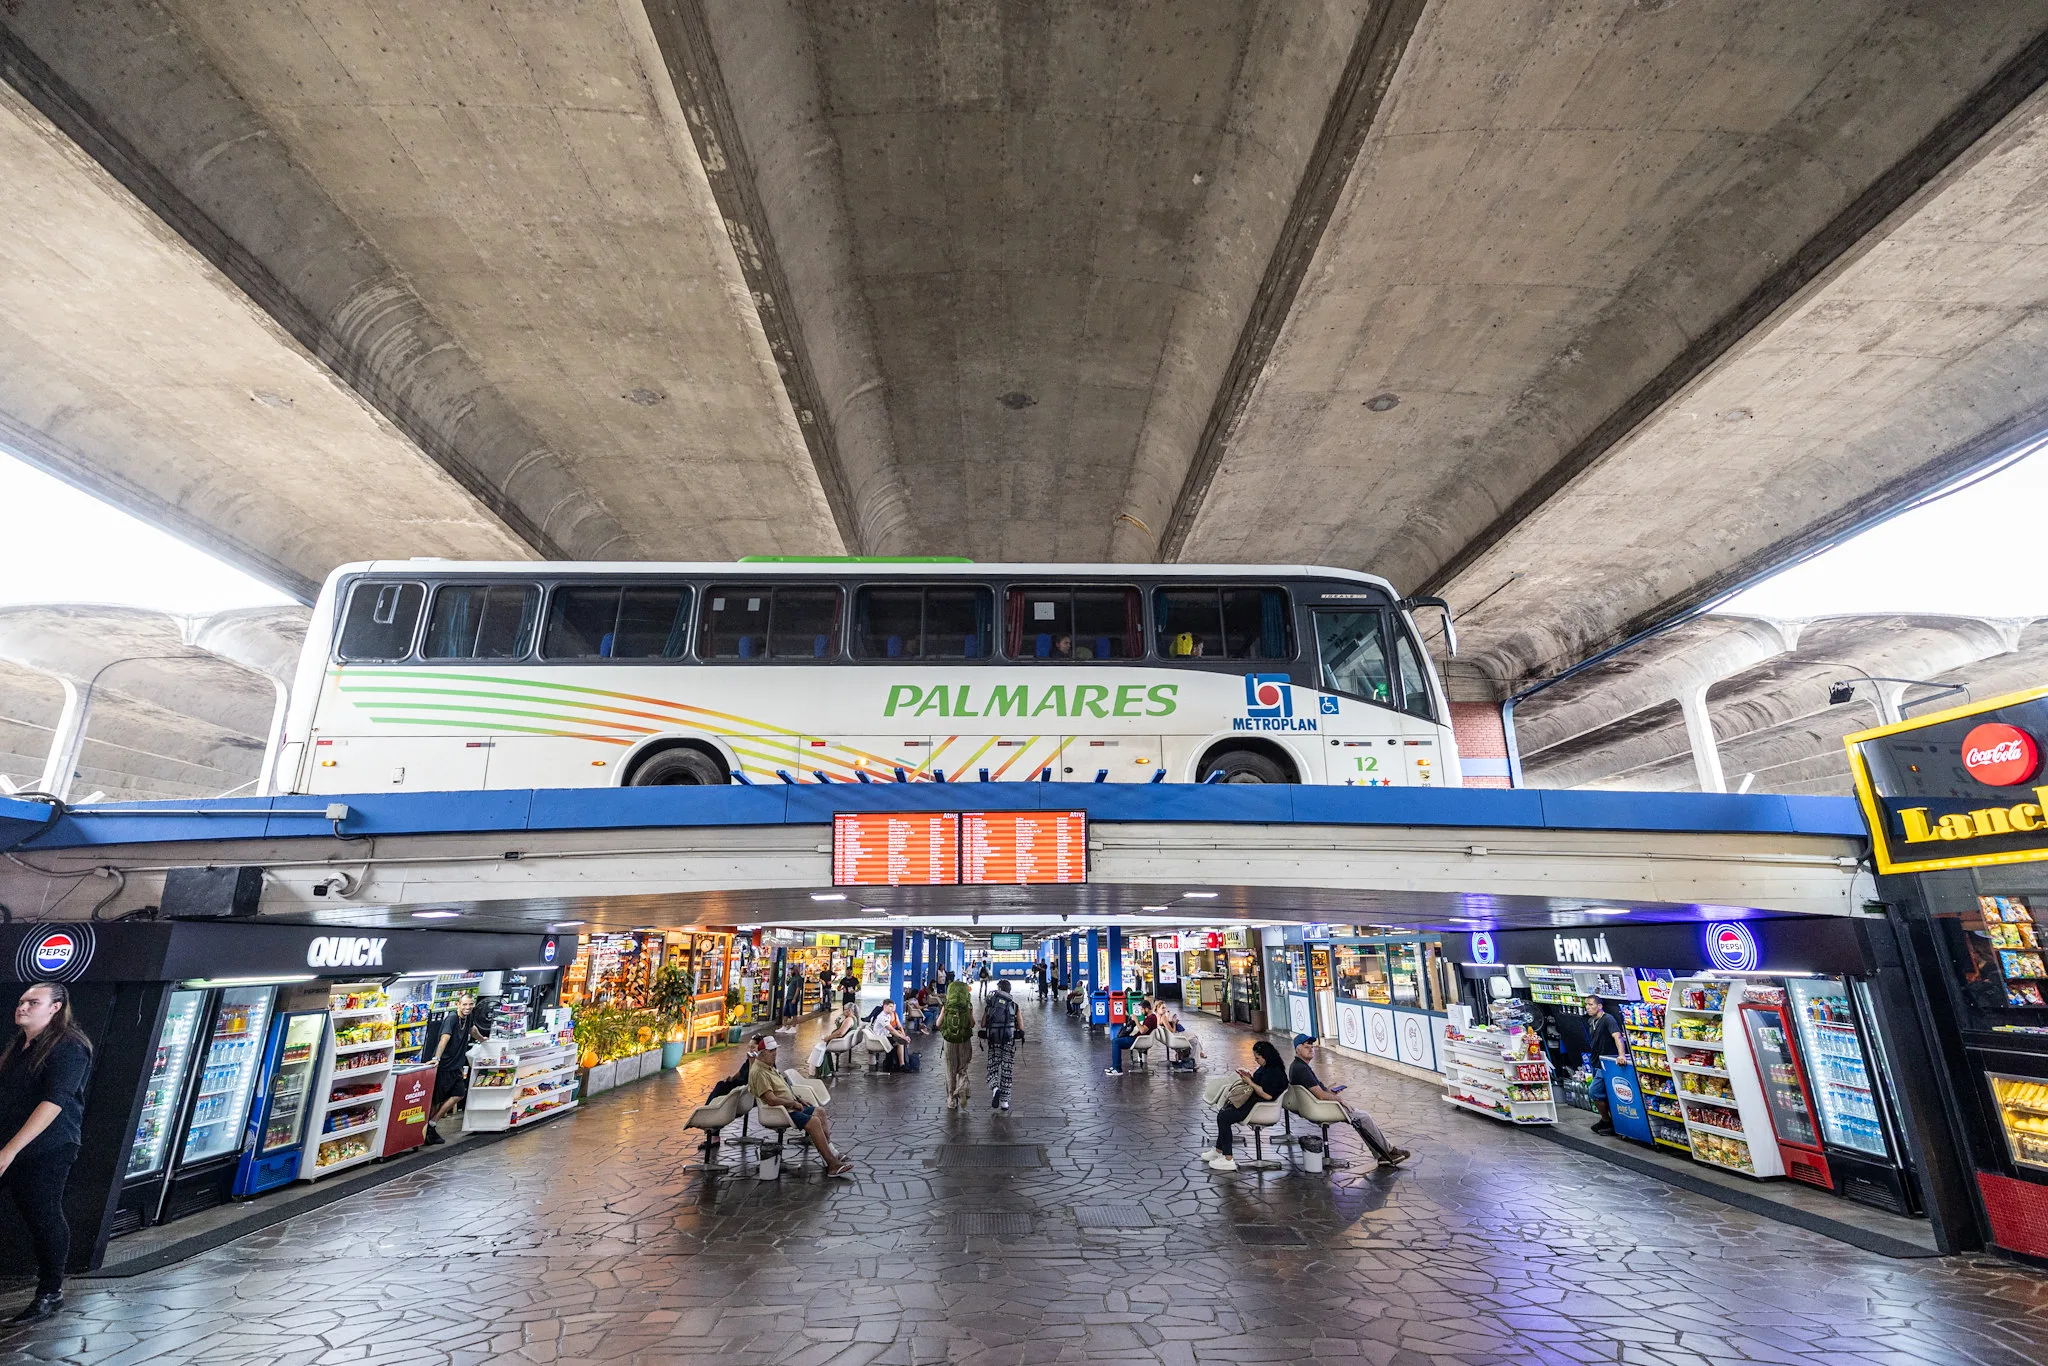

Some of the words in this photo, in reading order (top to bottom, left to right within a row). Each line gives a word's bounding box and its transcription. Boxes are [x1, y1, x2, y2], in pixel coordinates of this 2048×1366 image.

[884, 684, 1179, 719] PALMARES
[1233, 718, 1317, 730] METROPLAN
[1354, 756, 1379, 771] 12
[1965, 738, 2023, 768] Coca-Cola
[38, 948, 71, 957] PEPSI
[307, 936, 388, 967] QUICK
